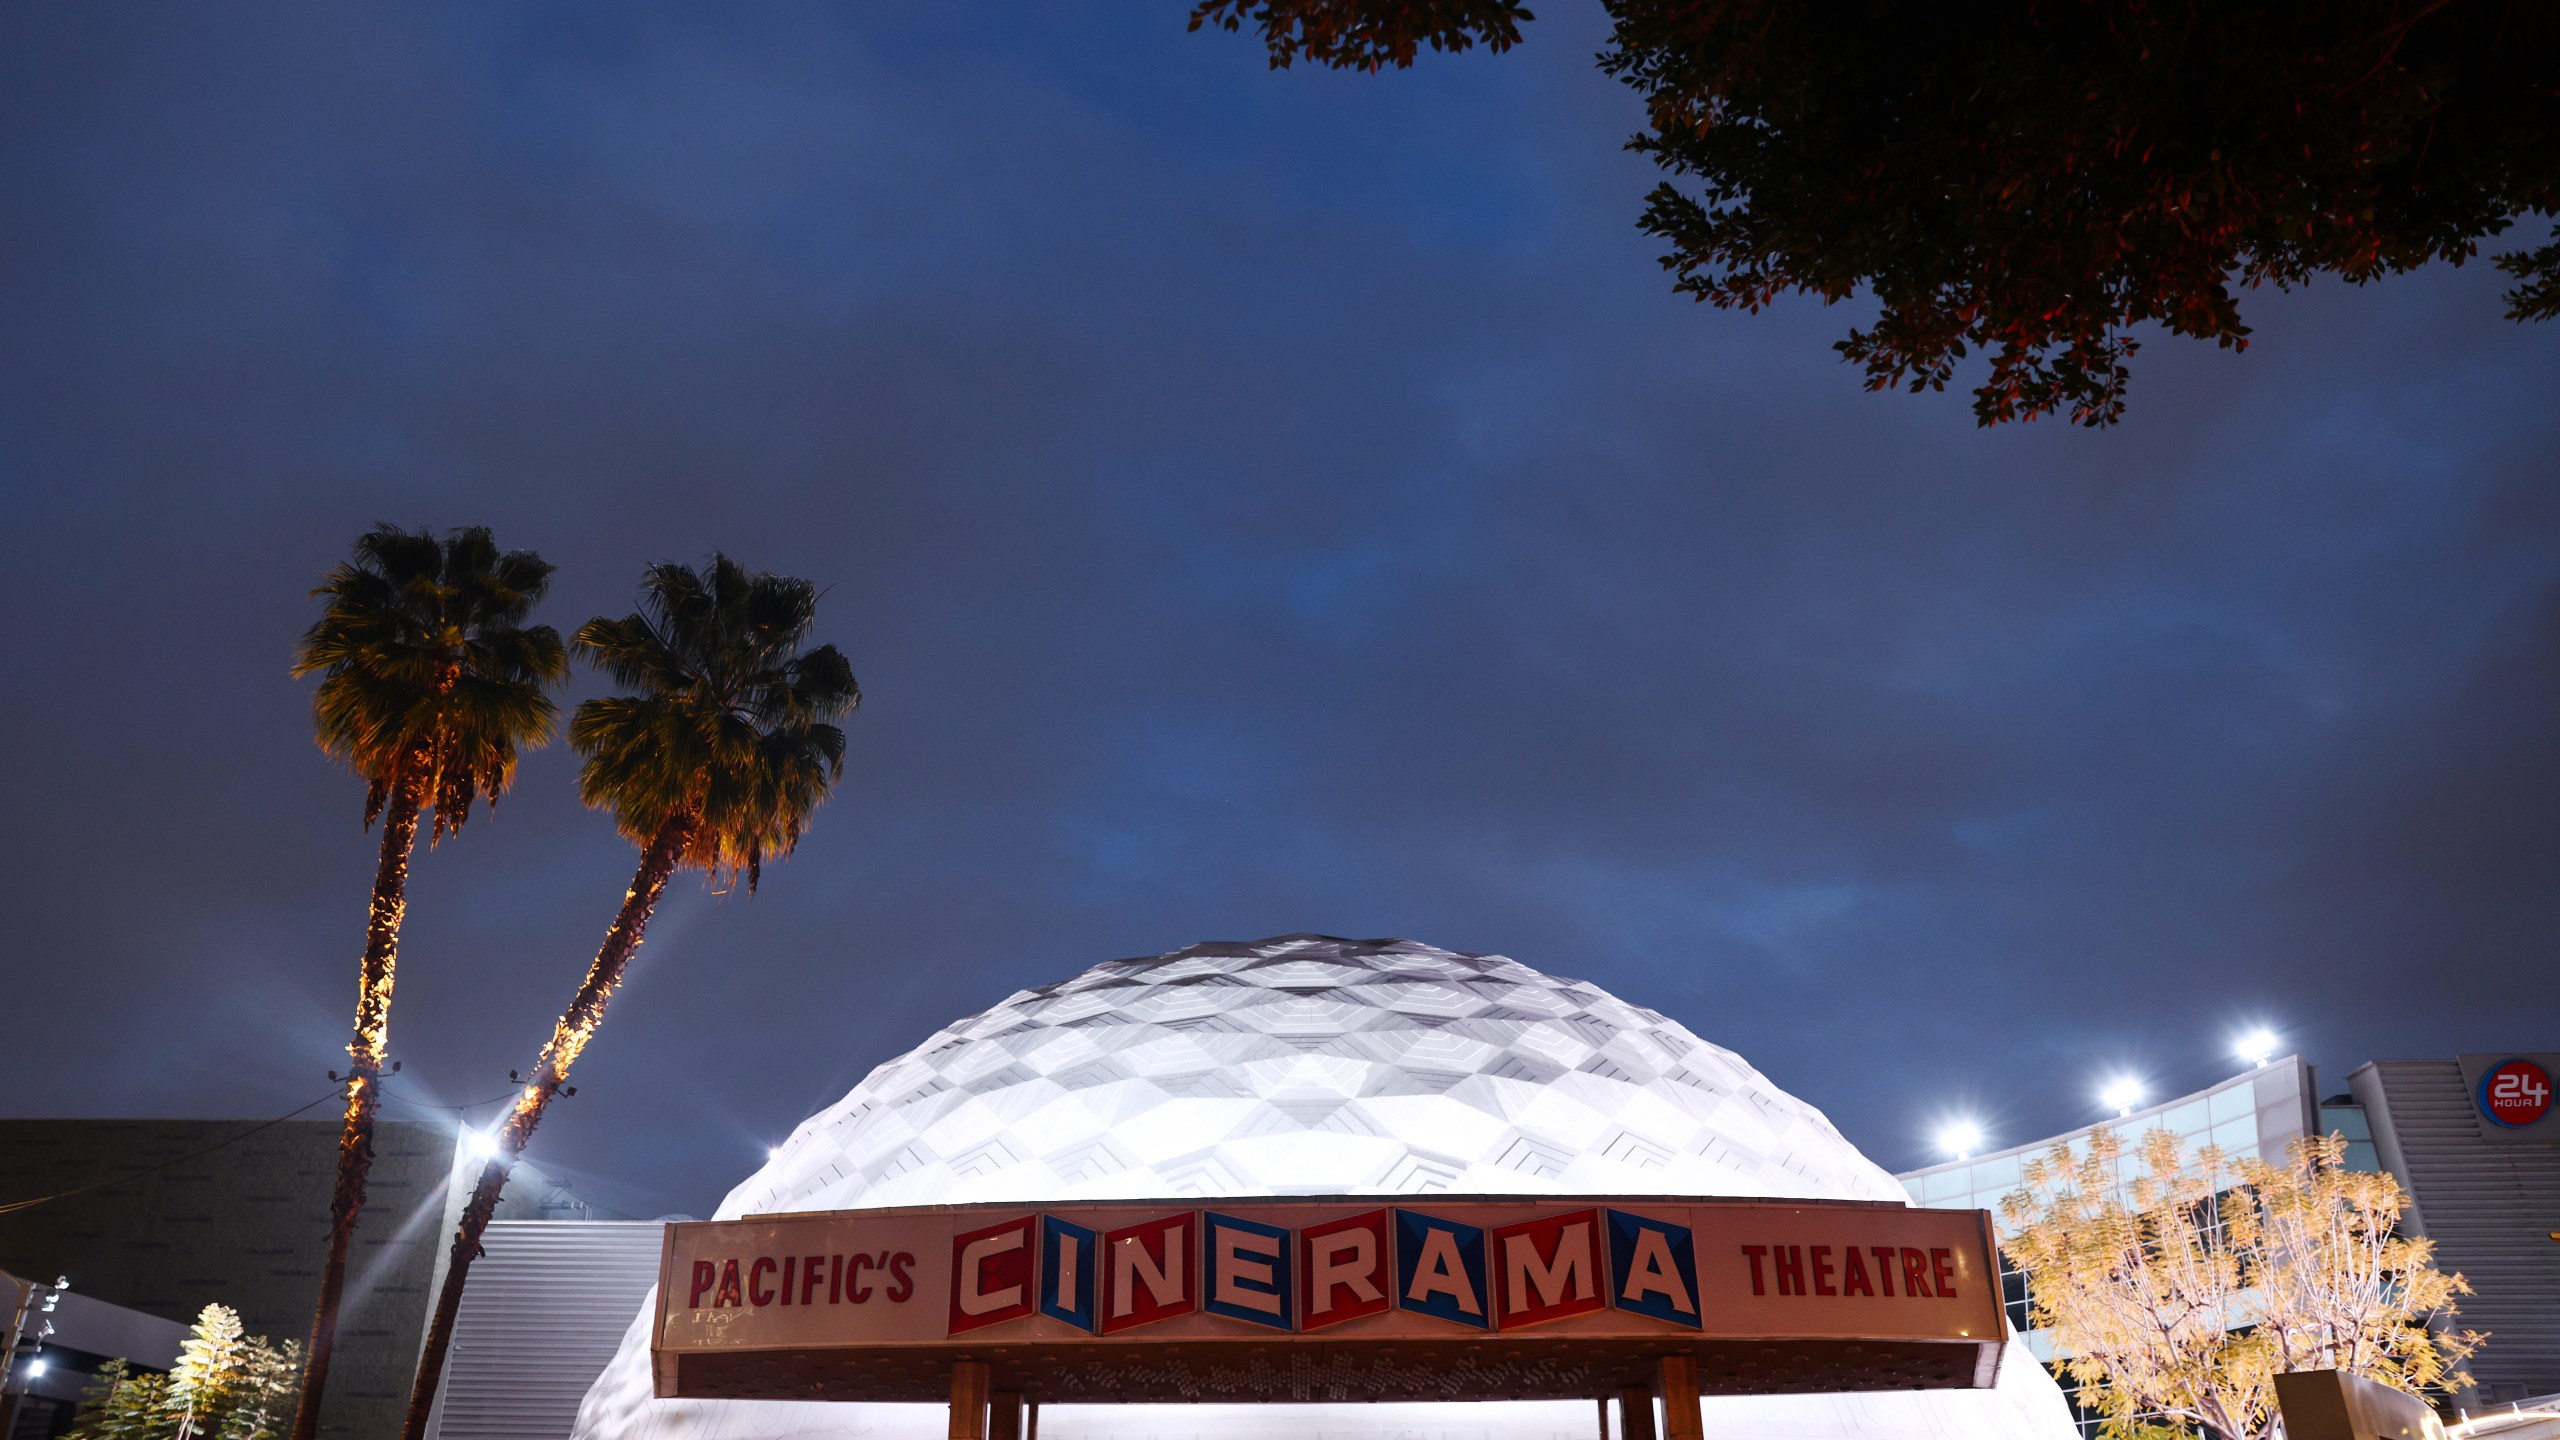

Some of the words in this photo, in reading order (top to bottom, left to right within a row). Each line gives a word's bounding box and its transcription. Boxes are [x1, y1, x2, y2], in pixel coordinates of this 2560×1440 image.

[2494, 1074, 2549, 1107] 24
[2494, 1099, 2533, 1108] HOUR
[688, 1251, 916, 1309] PACIFIC'S
[959, 1221, 1697, 1318] CINERAMA
[1741, 1245, 1958, 1298] THEATRE
